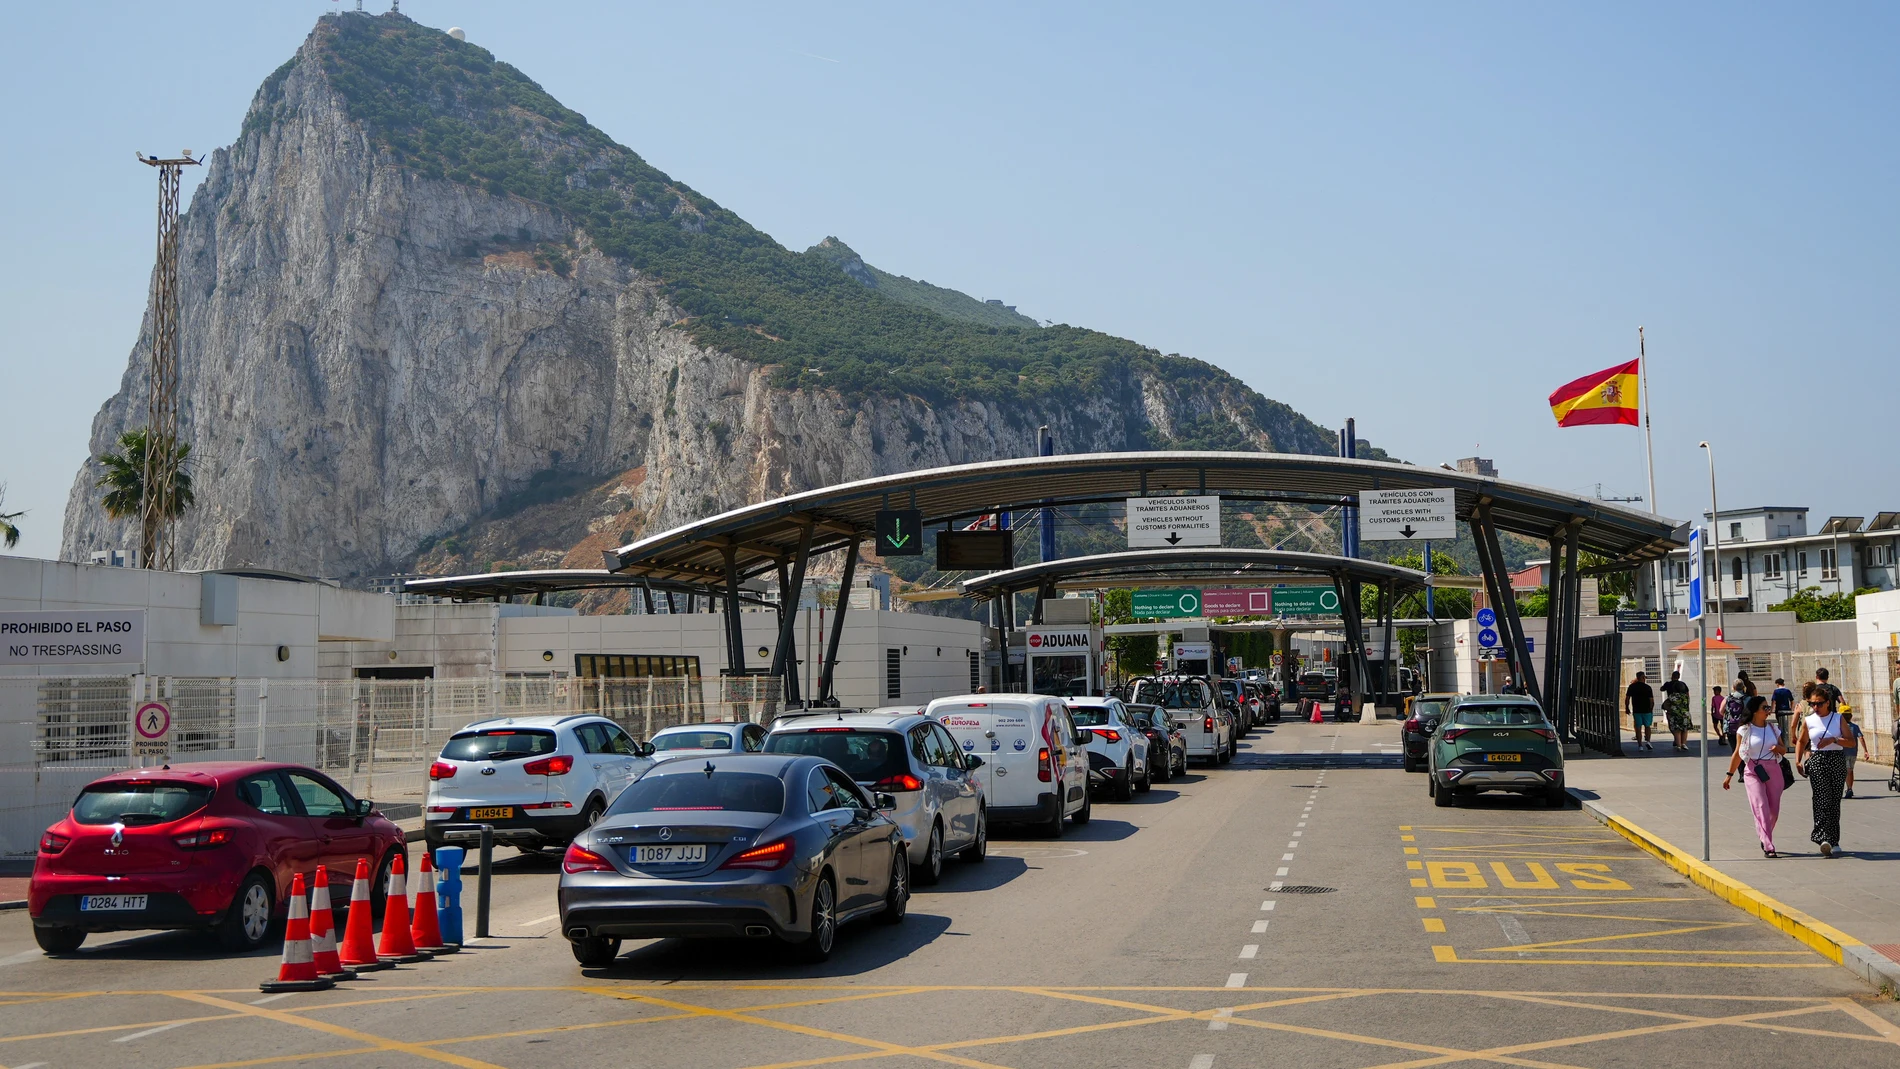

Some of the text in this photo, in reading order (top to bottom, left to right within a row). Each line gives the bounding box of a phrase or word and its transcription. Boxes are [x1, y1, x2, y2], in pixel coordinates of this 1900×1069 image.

[1, 621, 132, 634] PROHIBIDO EL PASO
[1042, 634, 1088, 647] ADUANA
[9, 644, 122, 656] NO TRESPASSING
[502, 808, 508, 817] E
[641, 847, 702, 860] 1087 JJJ
[1425, 862, 1634, 890] BUS
[90, 897, 142, 909] 0284 HTT
